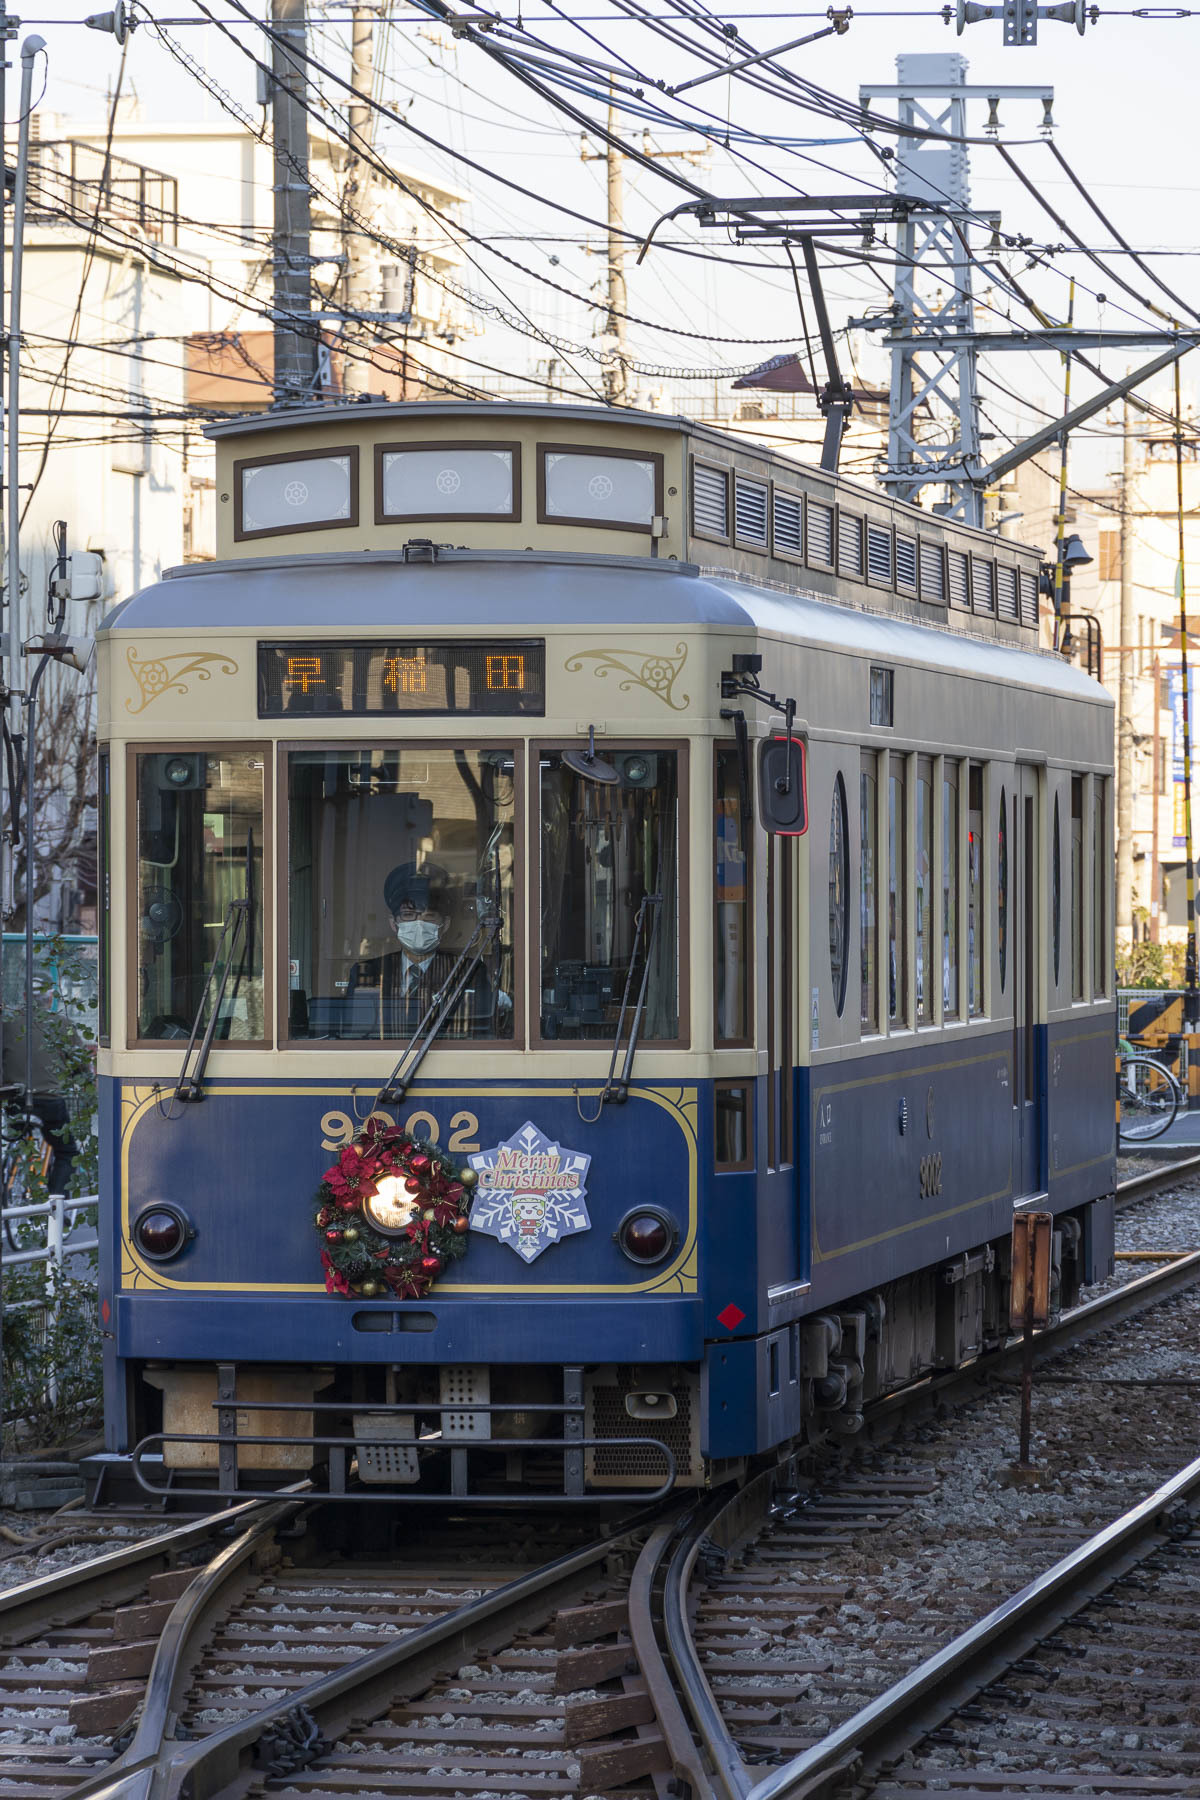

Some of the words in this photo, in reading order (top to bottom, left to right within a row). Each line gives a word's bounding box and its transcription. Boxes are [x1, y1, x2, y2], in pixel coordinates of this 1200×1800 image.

[284, 656, 524, 693] 早稲田
[496, 1150, 561, 1174] Merry
[920, 1152, 942, 1199] 9002
[478, 1169, 580, 1189] Christmas
